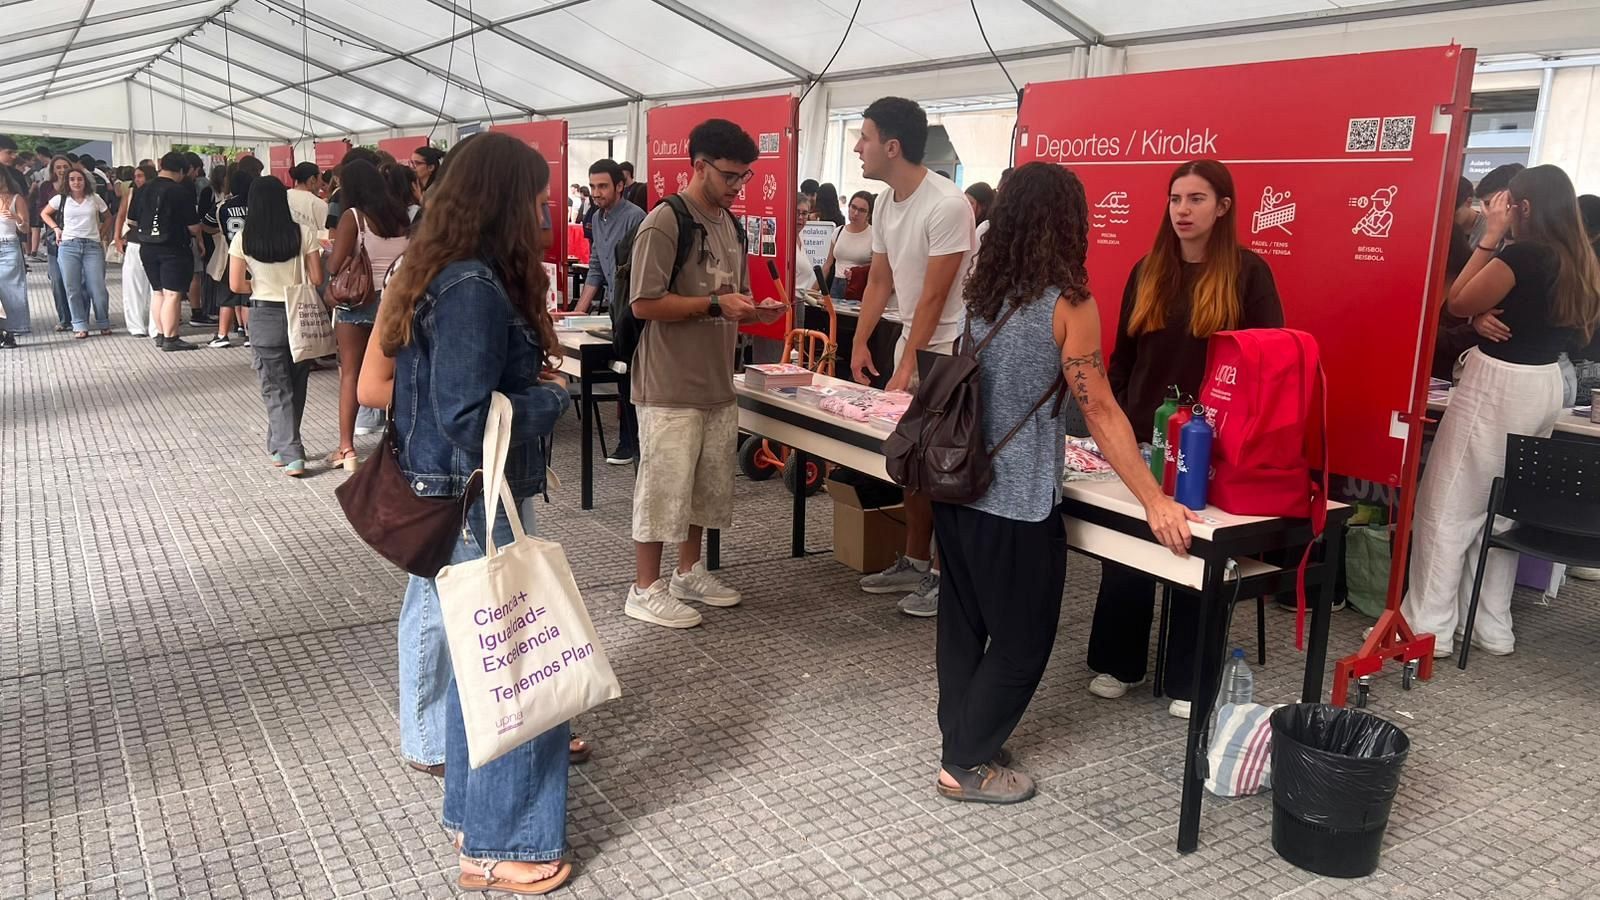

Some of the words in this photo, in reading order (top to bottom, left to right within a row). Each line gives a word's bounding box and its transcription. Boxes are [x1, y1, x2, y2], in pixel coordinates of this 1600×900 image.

[653, 140, 678, 155] Cultura
[1035, 133, 1120, 162] Deportes
[1125, 130, 1137, 156] /
[1141, 128, 1218, 155] Kirolak
[1354, 254, 1385, 262] BEISBOLA
[473, 590, 528, 626] Ciencia+
[478, 606, 547, 651] Igualdad=
[482, 625, 560, 673] Excelencia
[489, 660, 561, 703] Tenemos
[561, 642, 594, 667] Plan
[495, 710, 524, 730] upna
